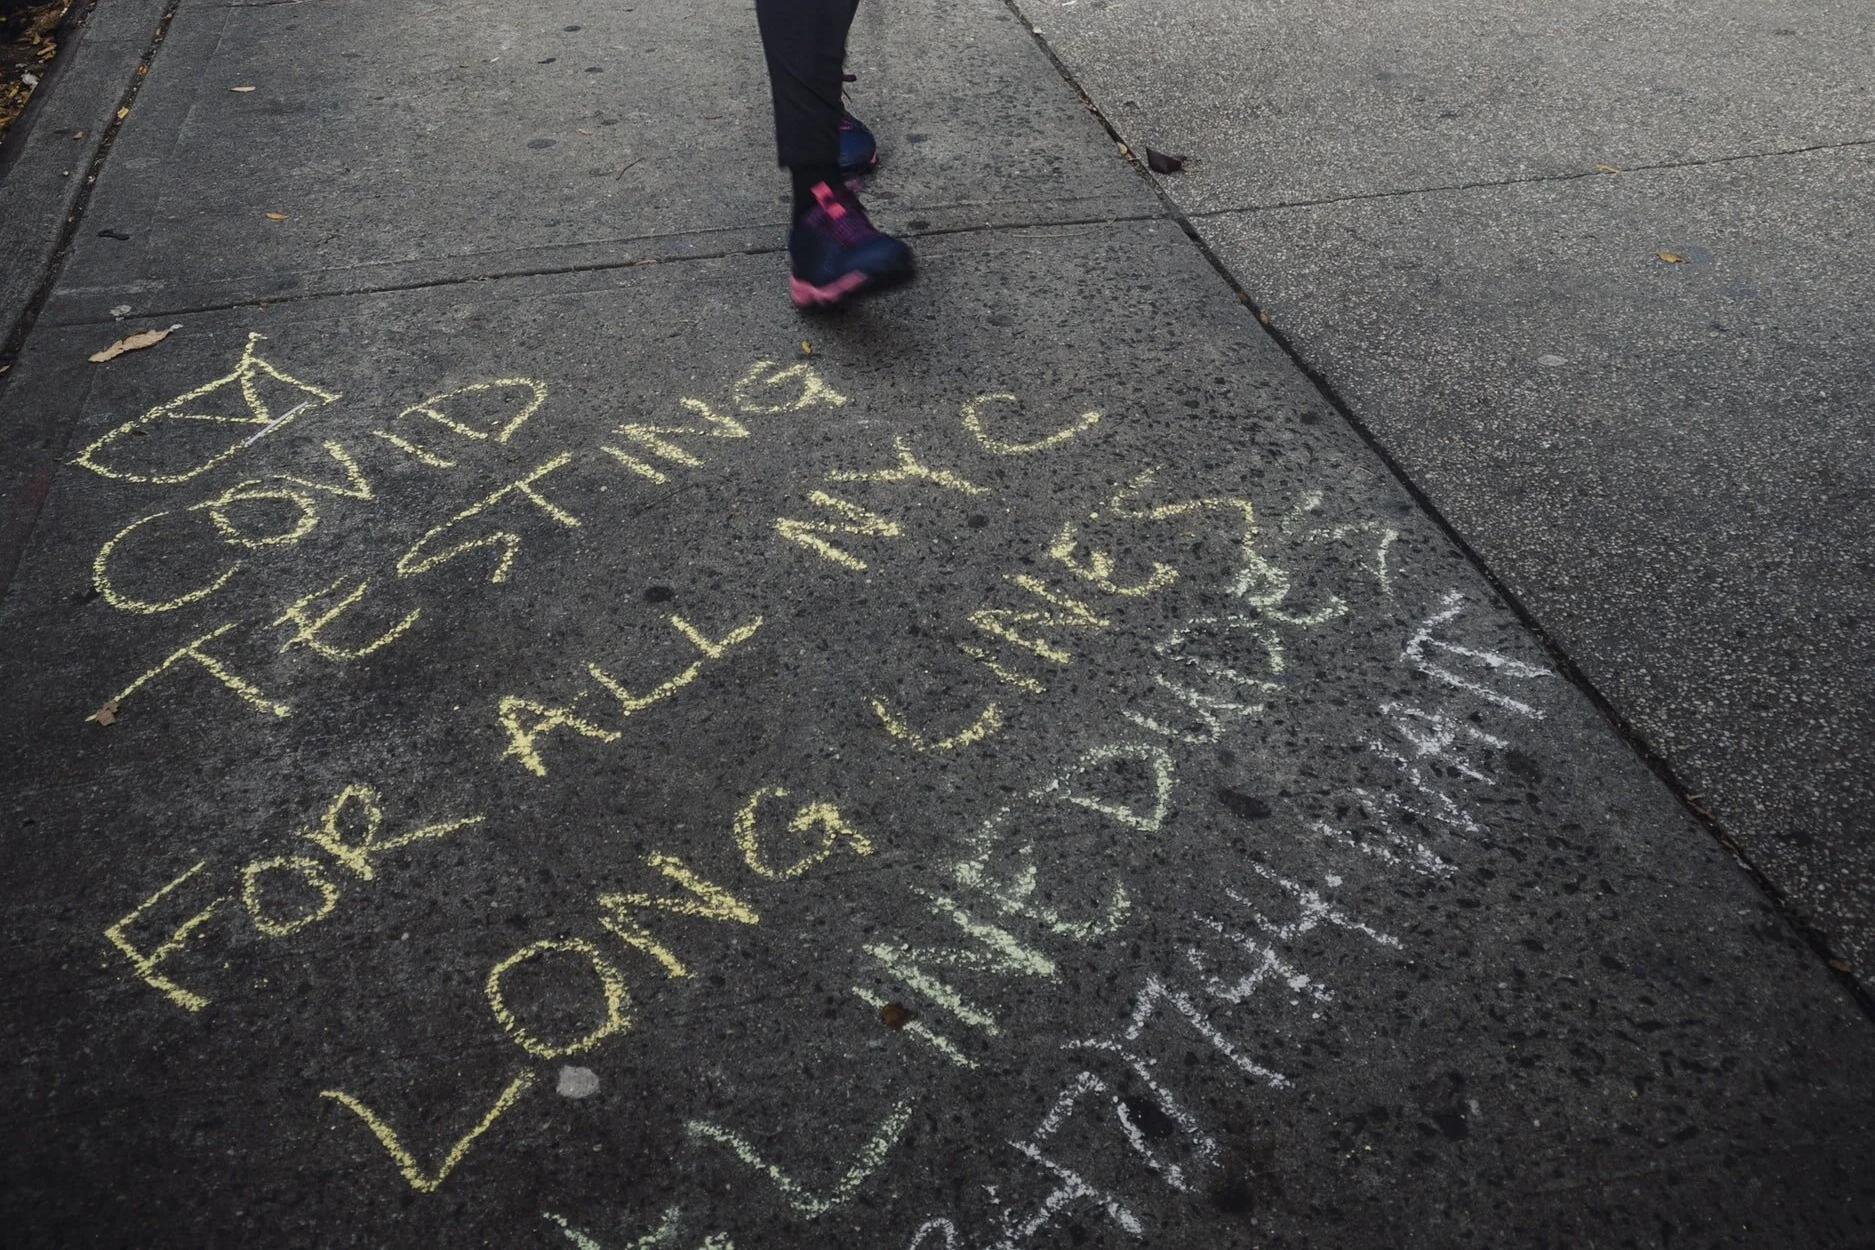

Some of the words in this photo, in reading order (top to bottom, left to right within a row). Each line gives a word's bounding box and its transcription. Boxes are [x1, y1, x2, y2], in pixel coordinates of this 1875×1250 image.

[86, 361, 848, 723] TESTING
[94, 378, 549, 614] COVID
[104, 785, 486, 1012] FOR
[498, 615, 763, 776] ALL
[775, 393, 1102, 570] NYC
[320, 787, 874, 1192] LONG
[871, 468, 1258, 752] LINES
